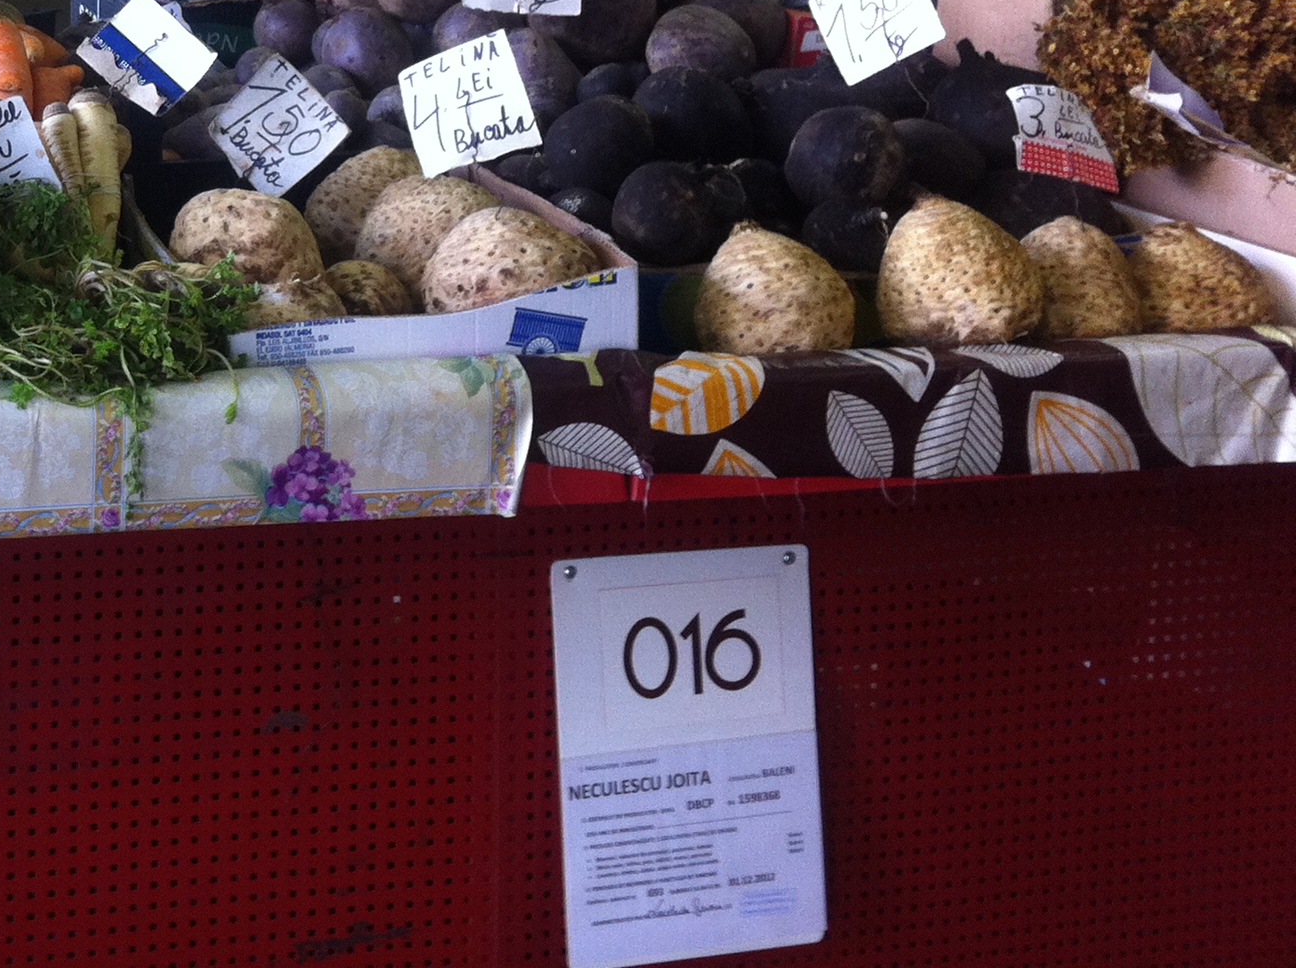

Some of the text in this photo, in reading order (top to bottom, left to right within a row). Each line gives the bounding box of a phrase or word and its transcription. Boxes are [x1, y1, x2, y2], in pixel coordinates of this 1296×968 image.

[623, 608, 762, 699] 016
[568, 776, 662, 801] NECULESCU
[665, 770, 712, 790] JOITA
